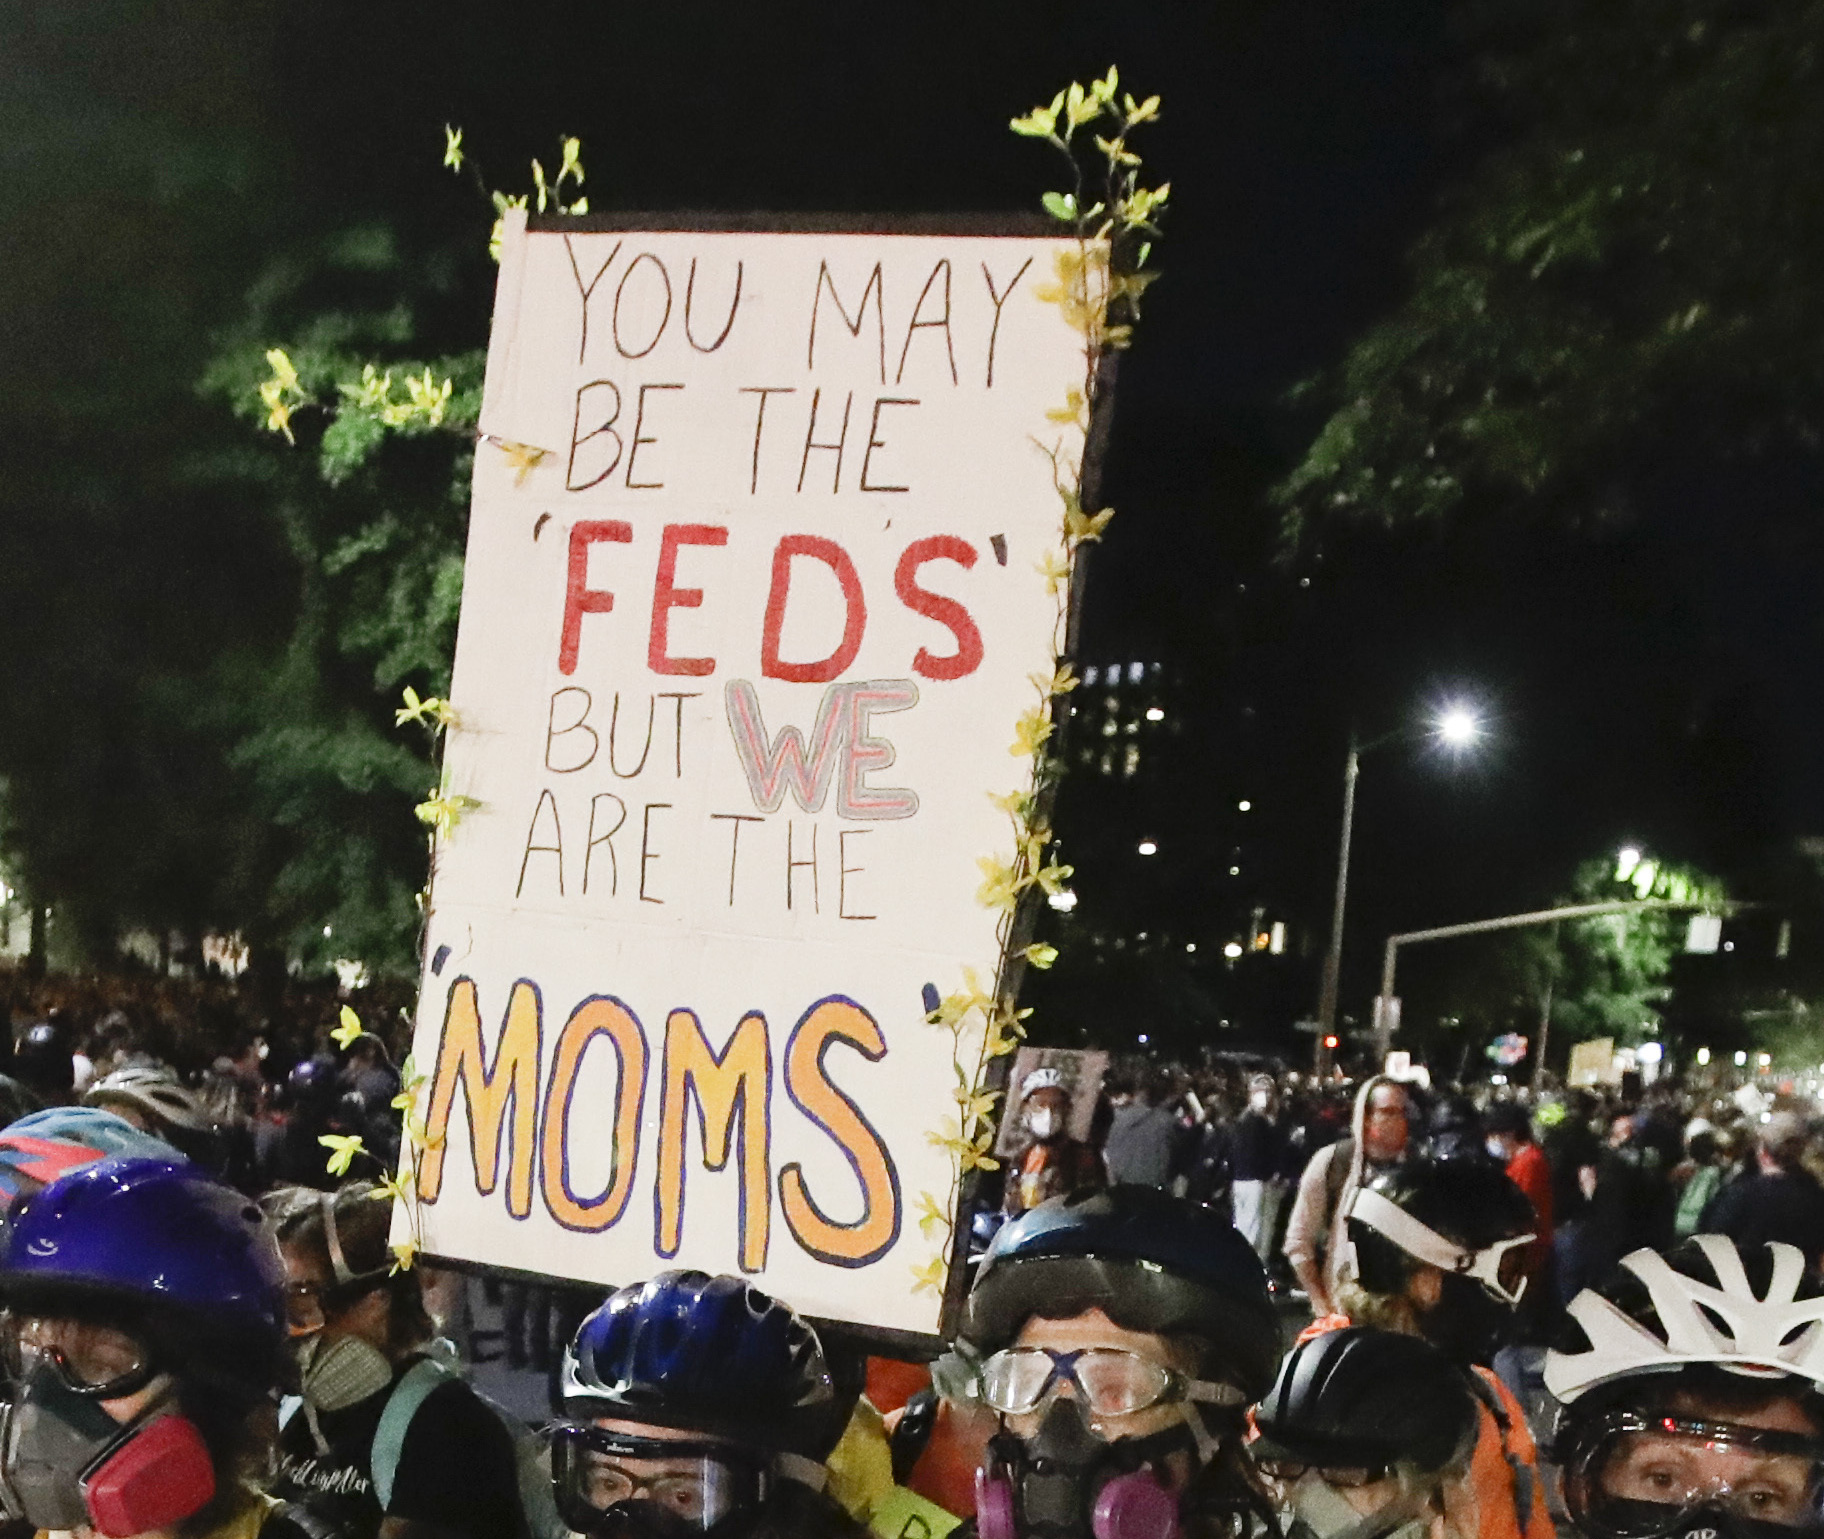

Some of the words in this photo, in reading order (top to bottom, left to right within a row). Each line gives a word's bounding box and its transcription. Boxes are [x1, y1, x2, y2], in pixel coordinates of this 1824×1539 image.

[564, 235, 743, 365] YOU
[808, 257, 1033, 388] MAY
[565, 380, 685, 491] BE
[739, 387, 921, 494] THE
[545, 686, 702, 778] BUT
[726, 678, 919, 820] WE
[517, 789, 673, 904] ARE
[711, 813, 878, 920] THE
